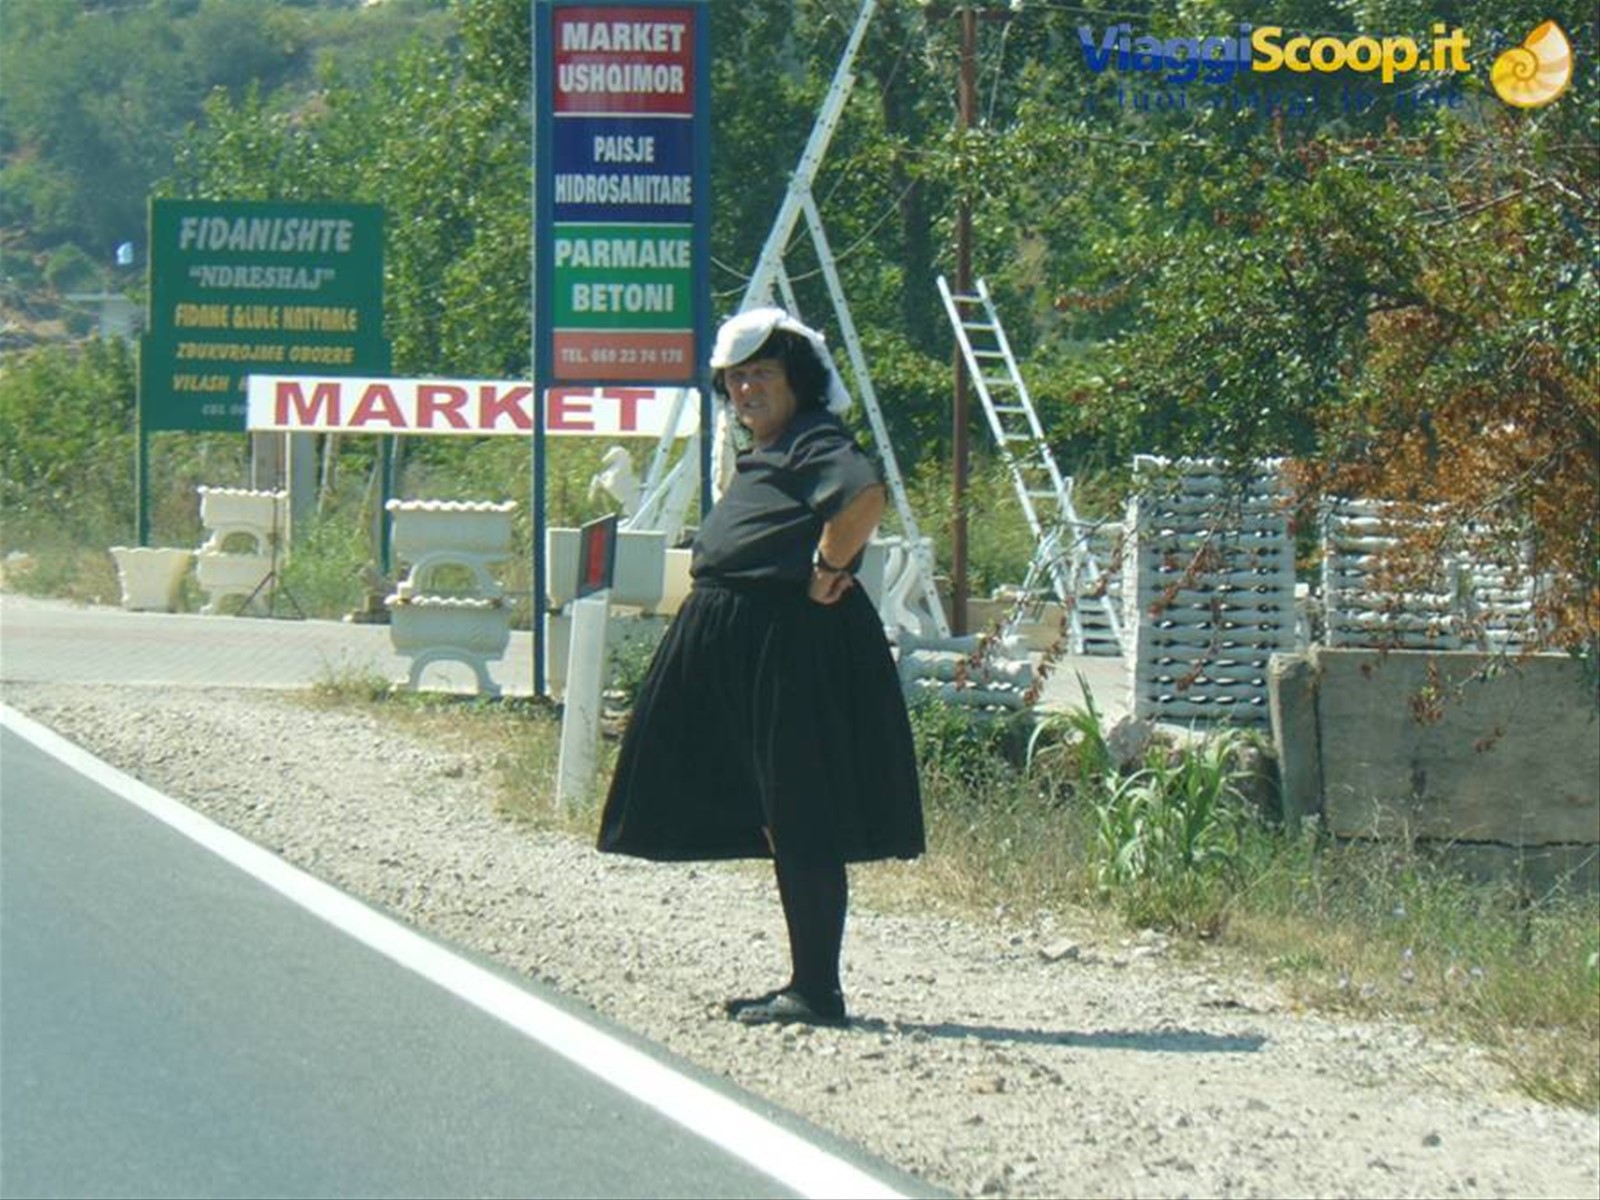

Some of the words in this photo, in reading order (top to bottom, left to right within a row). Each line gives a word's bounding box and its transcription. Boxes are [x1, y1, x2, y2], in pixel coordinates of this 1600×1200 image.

[562, 22, 685, 52] MARKET
[558, 63, 684, 93] USHQIMOR
[594, 135, 654, 162] PAISJE
[555, 173, 692, 205] HIDROSANITARE
[179, 216, 354, 252] FIDANISHTE
[554, 238, 691, 268] PARMAKE
[572, 283, 674, 313] BETONI
[274, 380, 656, 432] MARKET
